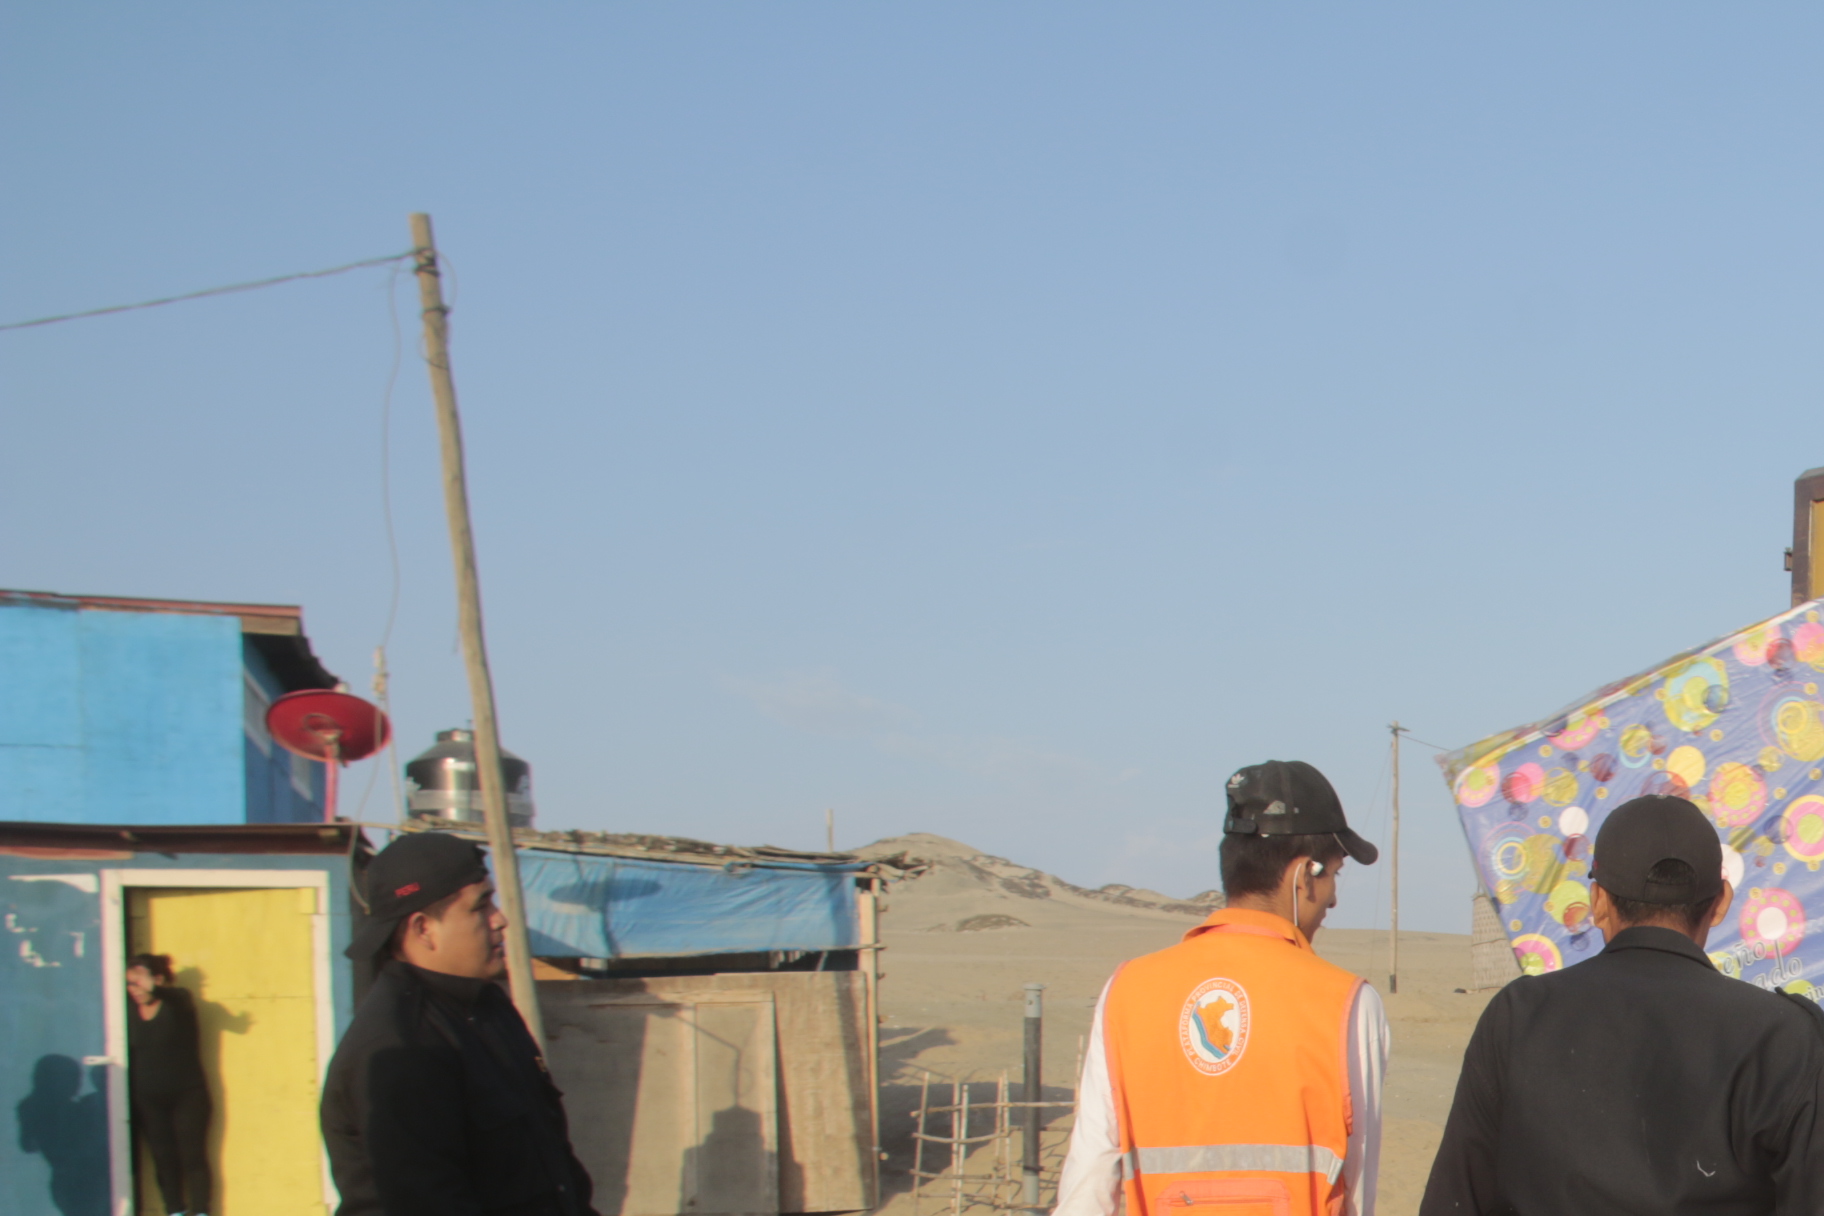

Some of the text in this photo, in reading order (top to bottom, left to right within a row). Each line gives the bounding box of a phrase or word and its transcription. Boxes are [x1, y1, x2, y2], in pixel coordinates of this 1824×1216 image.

[1722, 938, 1767, 975] eño
[1751, 940, 1803, 989] ado
[1192, 981, 1235, 1002] PROVINCIAL
[1194, 1058, 1232, 1072] CHIMBOTE
